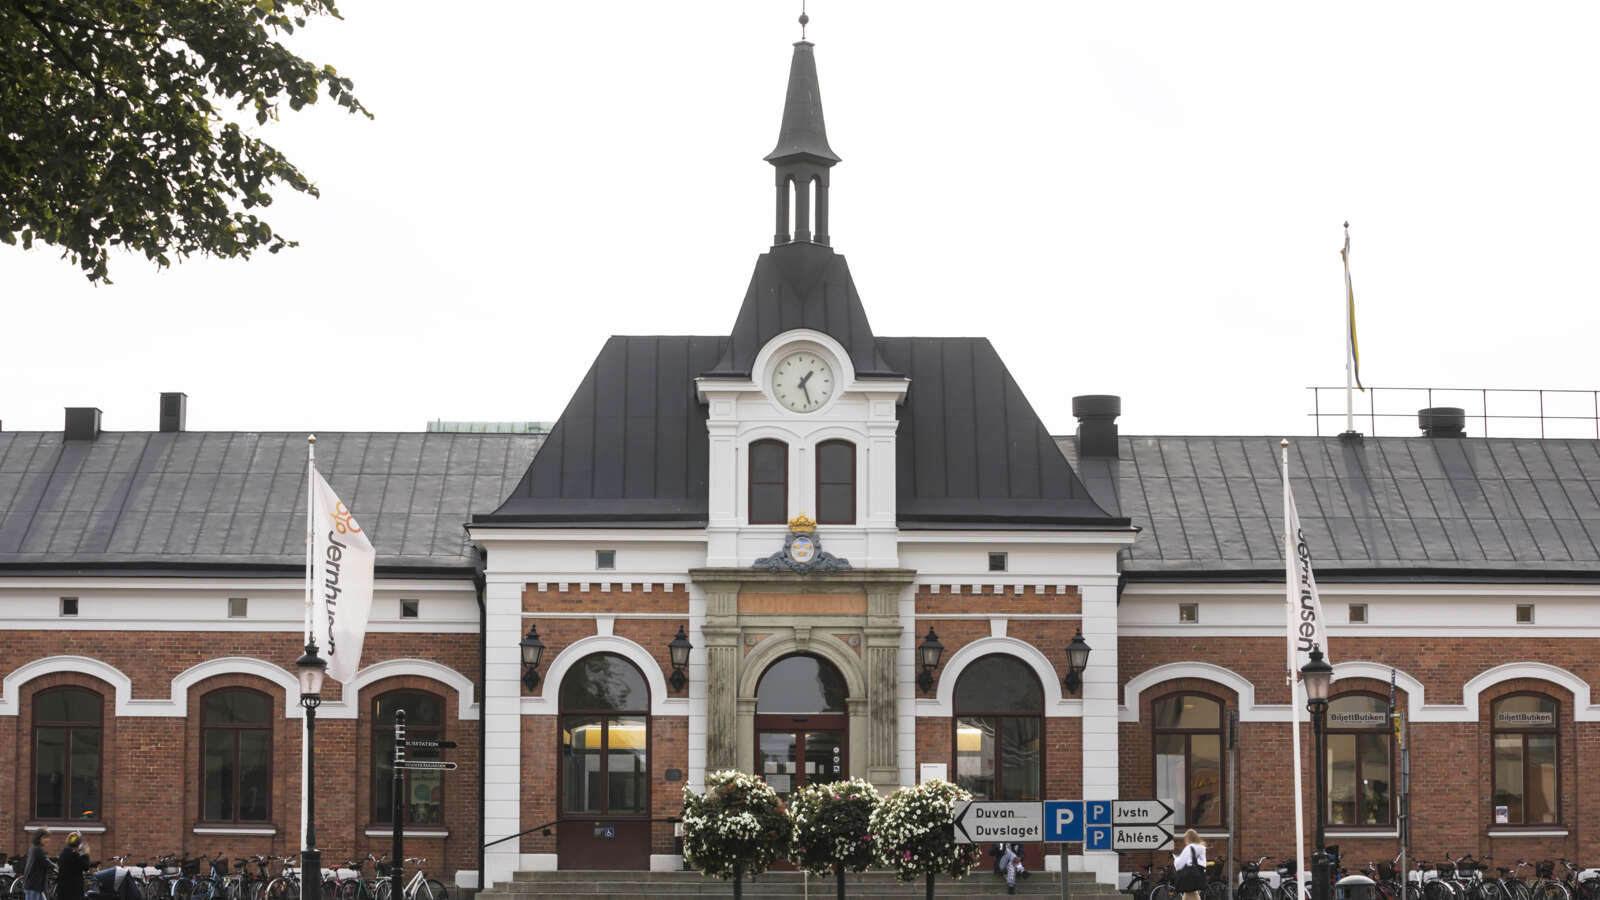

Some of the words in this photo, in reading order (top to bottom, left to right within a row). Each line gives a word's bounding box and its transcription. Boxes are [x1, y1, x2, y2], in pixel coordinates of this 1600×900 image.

[1331, 713, 1384, 721] BiljettButiken
[1499, 713, 1551, 721] BiljettButiken
[976, 808, 1015, 818] Duvan
[1093, 805, 1104, 820] P
[1117, 807, 1149, 817] Jvstn
[1056, 808, 1074, 835] P
[976, 825, 1038, 837] Duvslaget
[1117, 828, 1159, 843] Åhléns
[1093, 830, 1104, 846] P
